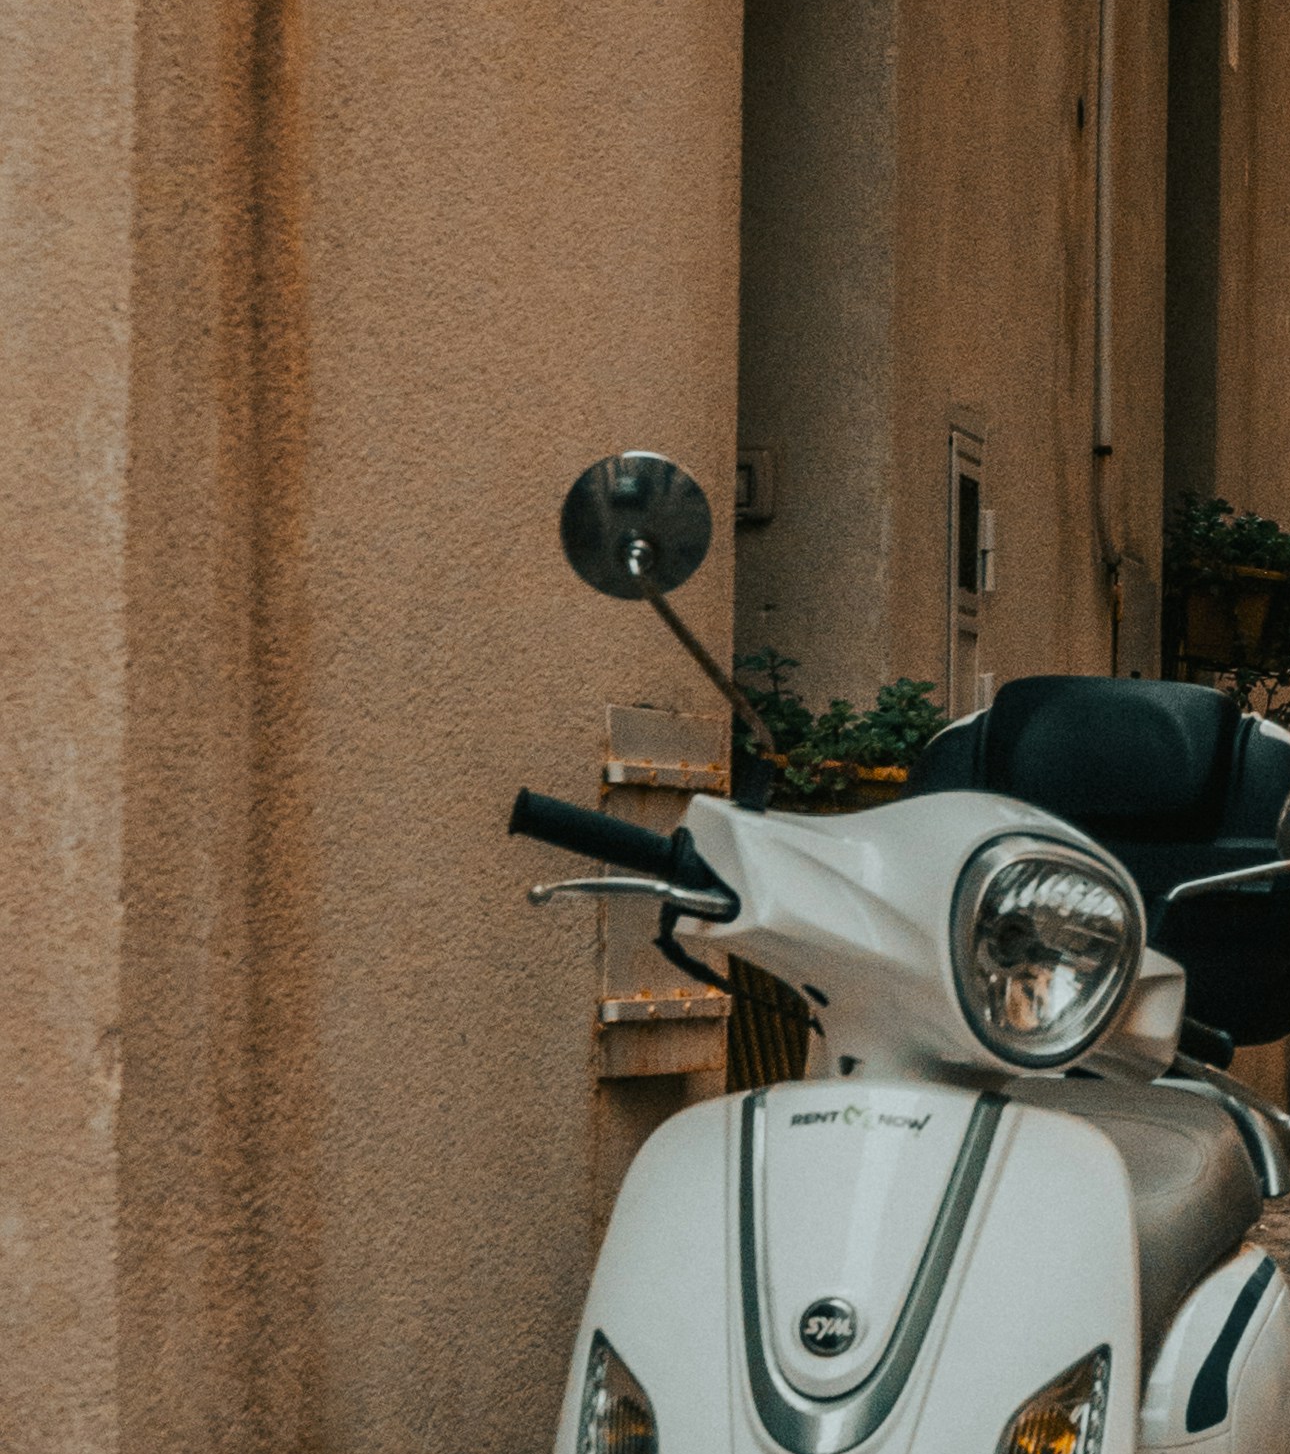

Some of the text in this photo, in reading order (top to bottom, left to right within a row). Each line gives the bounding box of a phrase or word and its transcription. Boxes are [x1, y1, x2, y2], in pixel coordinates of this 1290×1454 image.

[791, 1111, 932, 1131] RENT NOW
[804, 1316, 853, 1341] SYM
